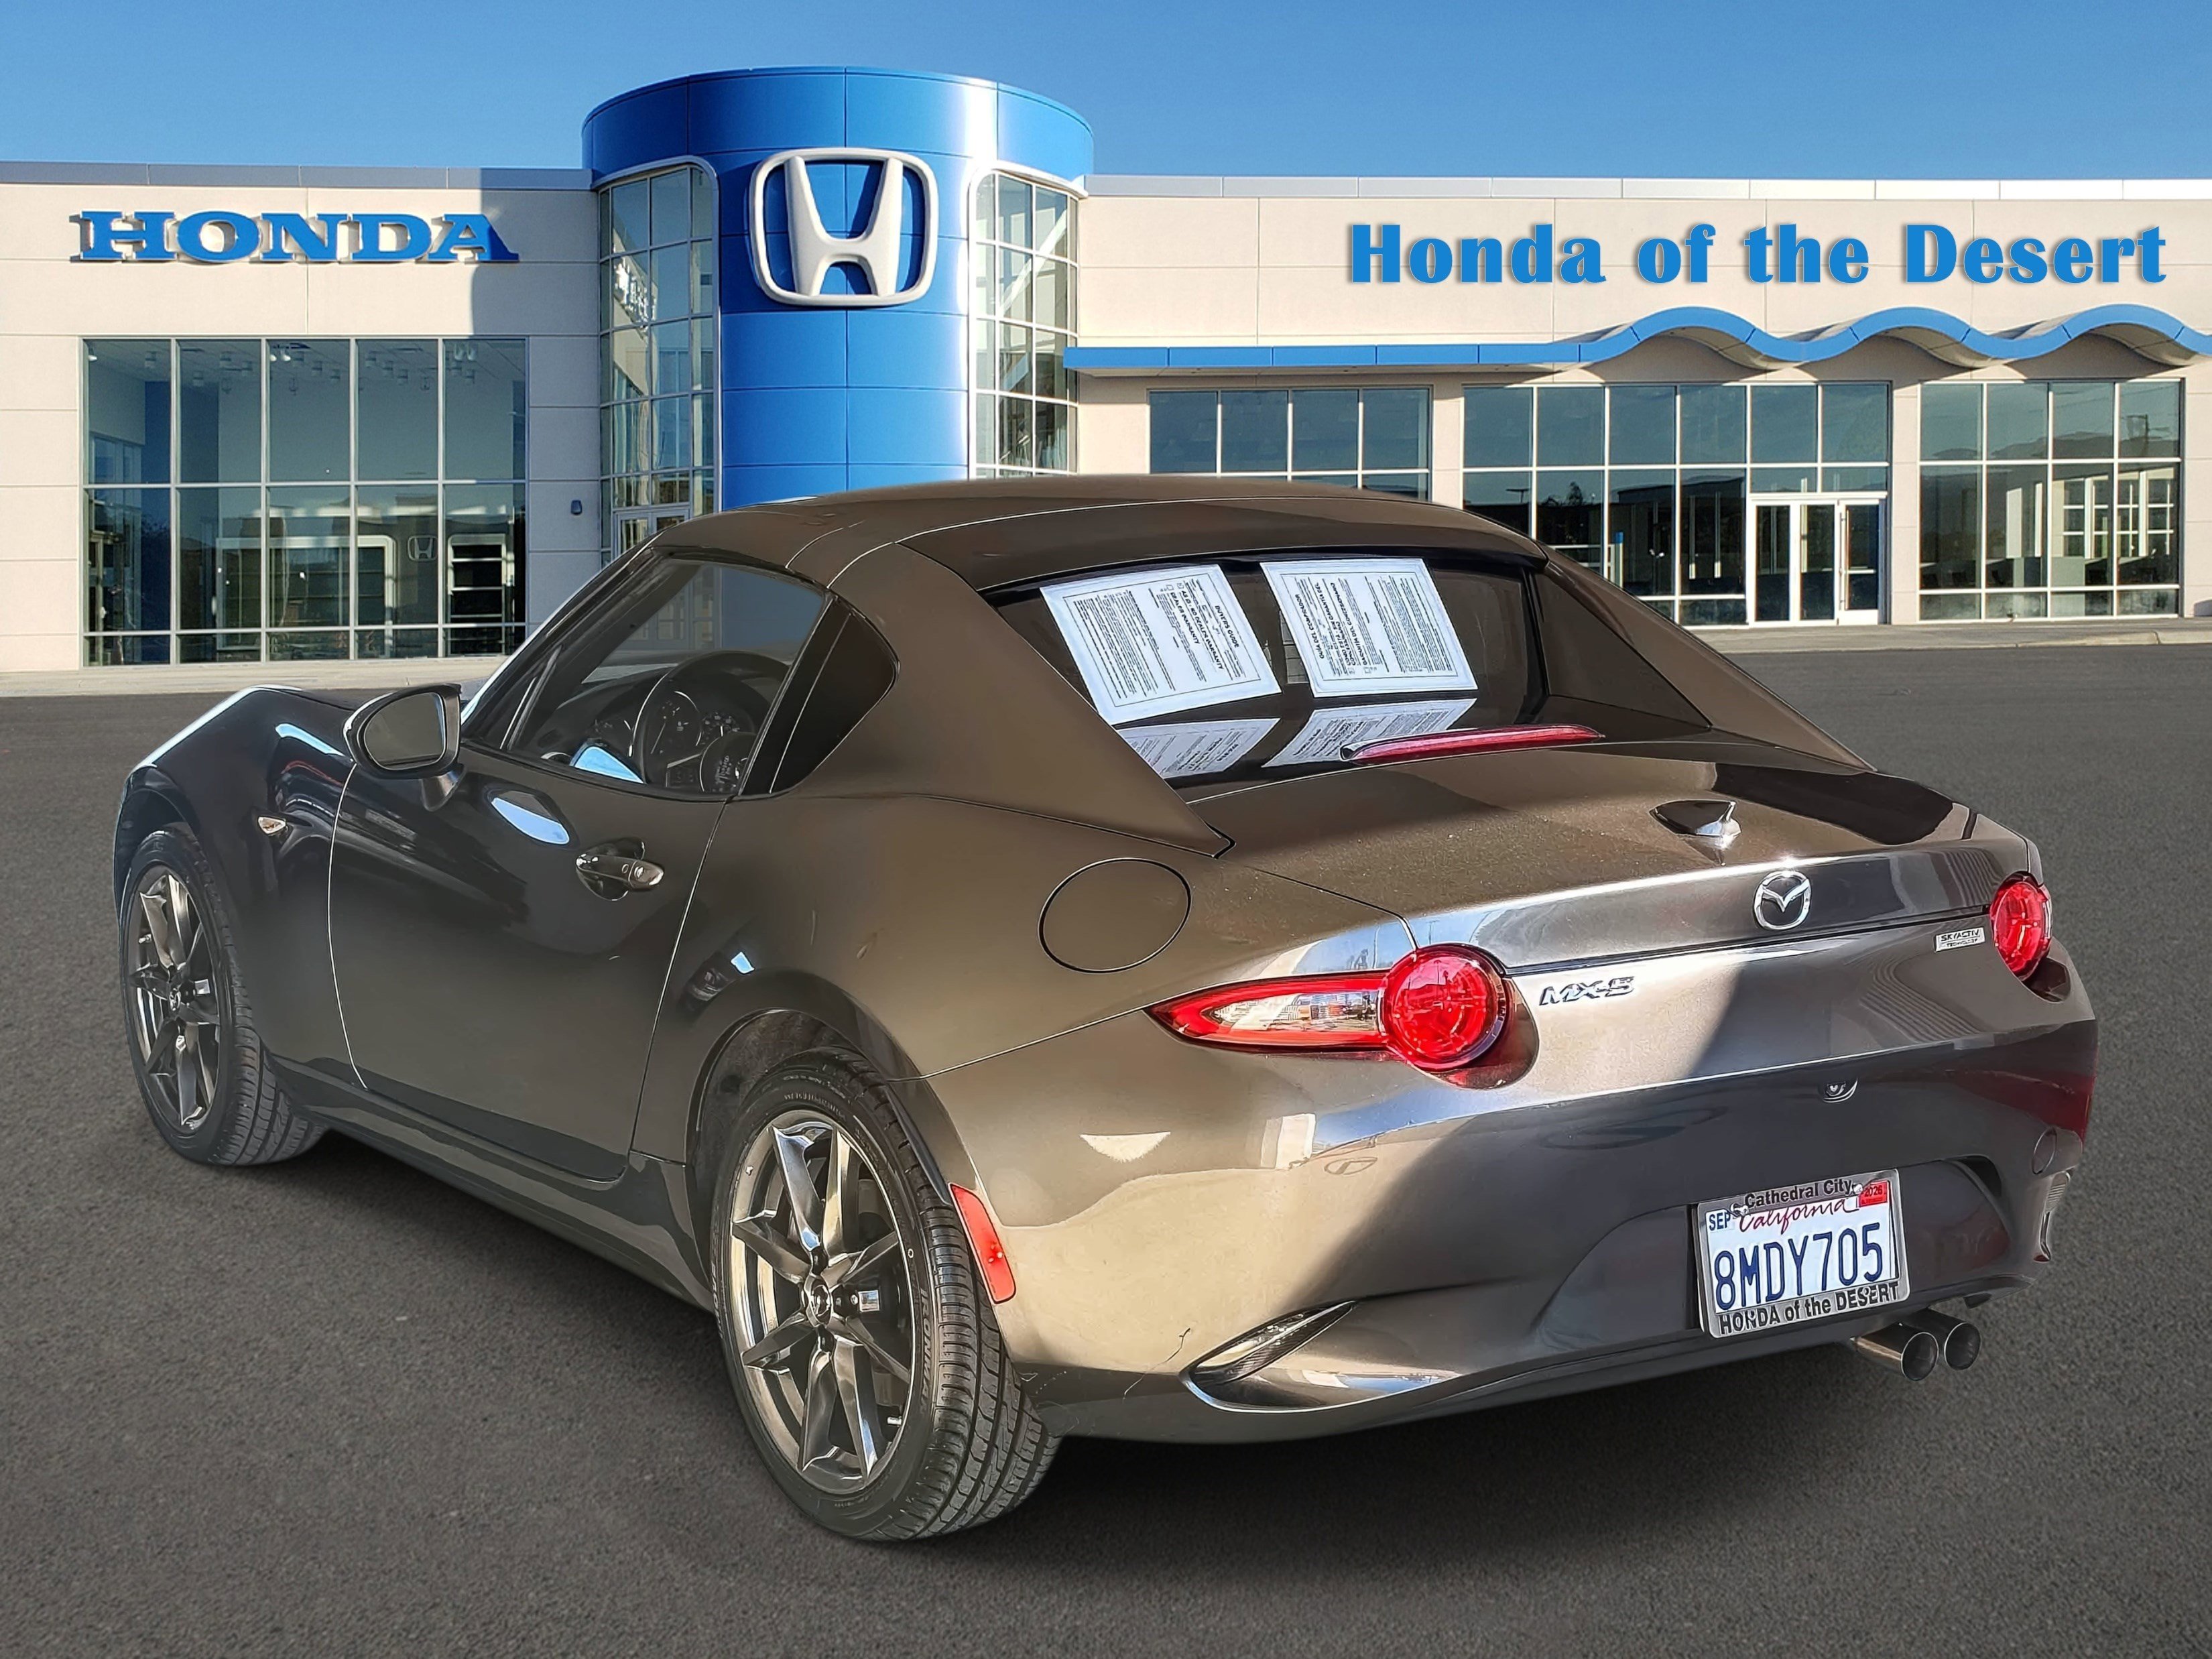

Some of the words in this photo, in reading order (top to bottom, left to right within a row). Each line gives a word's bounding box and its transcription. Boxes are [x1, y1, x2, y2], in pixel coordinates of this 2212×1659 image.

[74, 210, 519, 262] HONDA
[1351, 224, 1607, 283] Honda
[1638, 223, 1717, 283] of
[1743, 224, 1869, 283] the
[1906, 225, 2166, 283] Desert
[1941, 929, 1979, 942] SKYACTIV
[1539, 976, 1634, 1005] MX-5
[1744, 1184, 1819, 1209] Cathedral
[1823, 1178, 1853, 1196] City
[1864, 1184, 1883, 1197] 2026
[1709, 1211, 1730, 1231] SEP
[1739, 1198, 1859, 1235] California
[1714, 1222, 1884, 1311] 8MDY705
[1718, 1307, 1781, 1335] HONDA
[1784, 1300, 1800, 1321] of
[1806, 1296, 1831, 1317] the
[1835, 1282, 1899, 1311] DESERT
